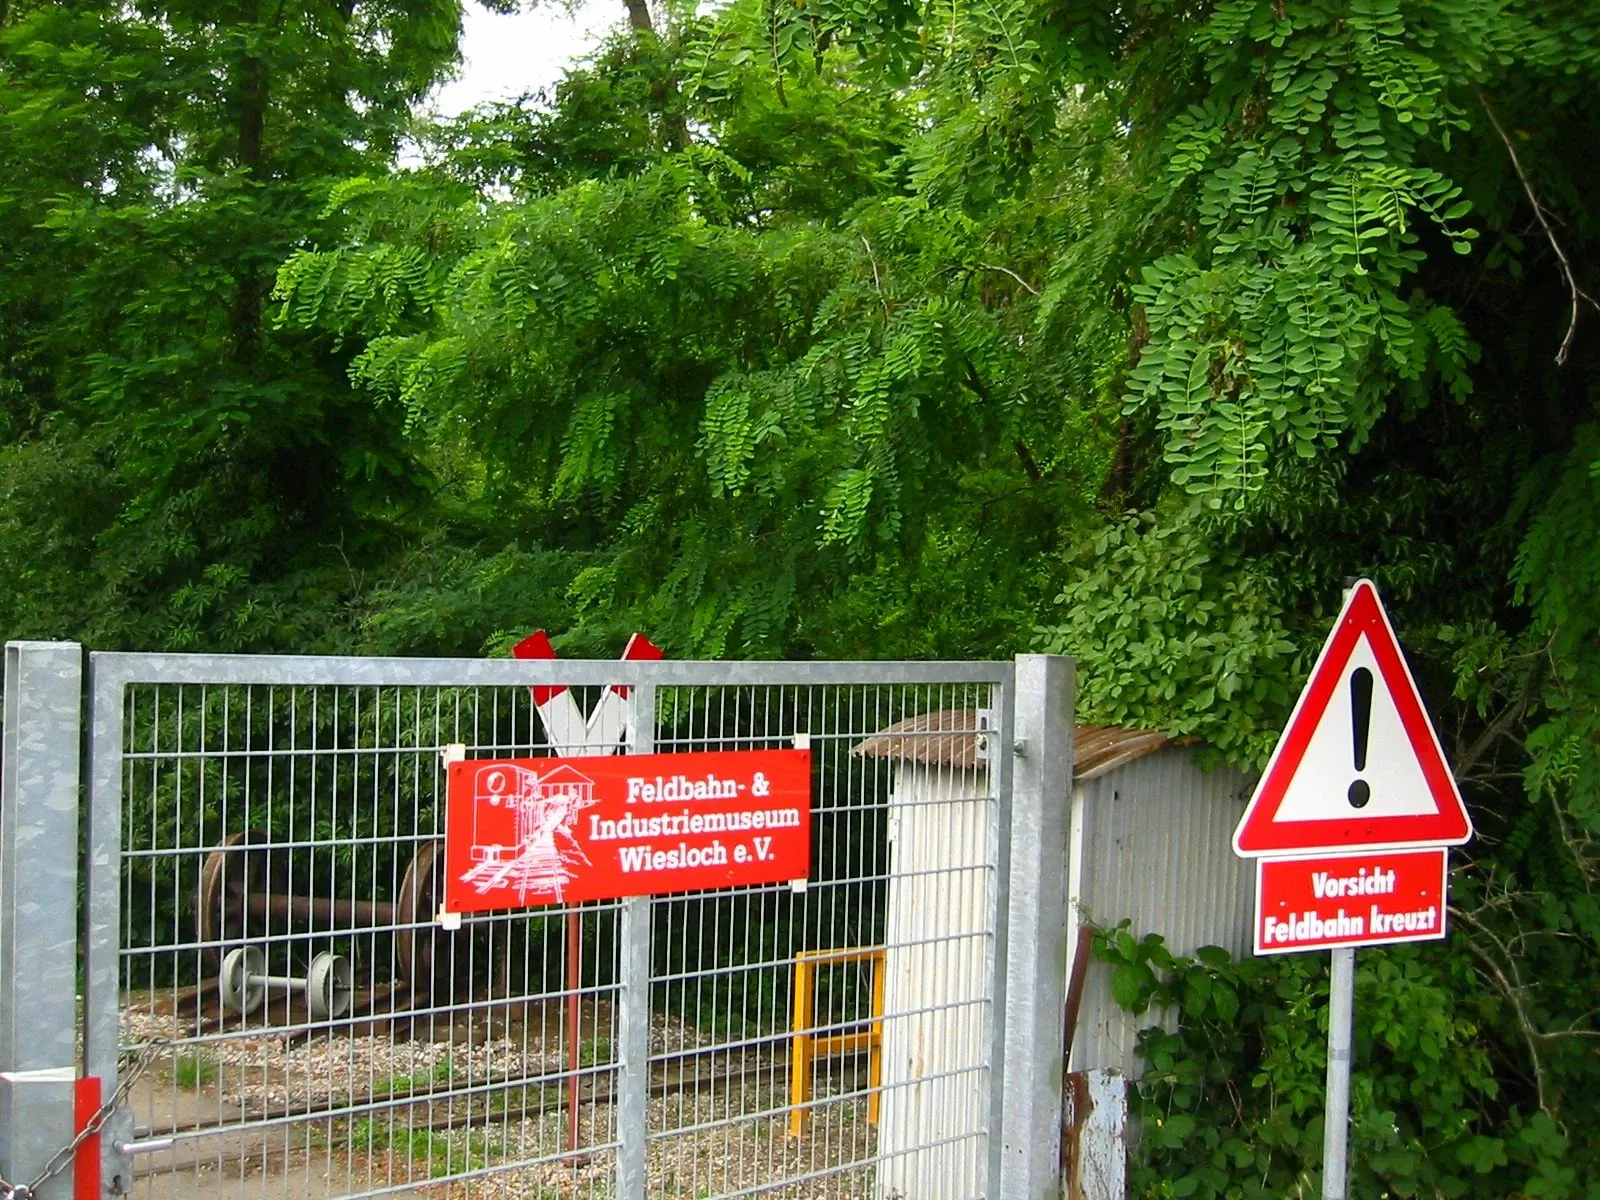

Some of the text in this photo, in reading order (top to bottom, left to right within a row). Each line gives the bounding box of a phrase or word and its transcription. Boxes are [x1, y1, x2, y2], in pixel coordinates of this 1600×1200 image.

[626, 771, 770, 804] Feldbahn- &
[588, 807, 800, 841] Industriemuseum
[619, 837, 775, 873] Wiesloch e.V.
[1311, 866, 1396, 899] Vorsicht
[1264, 904, 1436, 944] Feldbahn kreuzt
